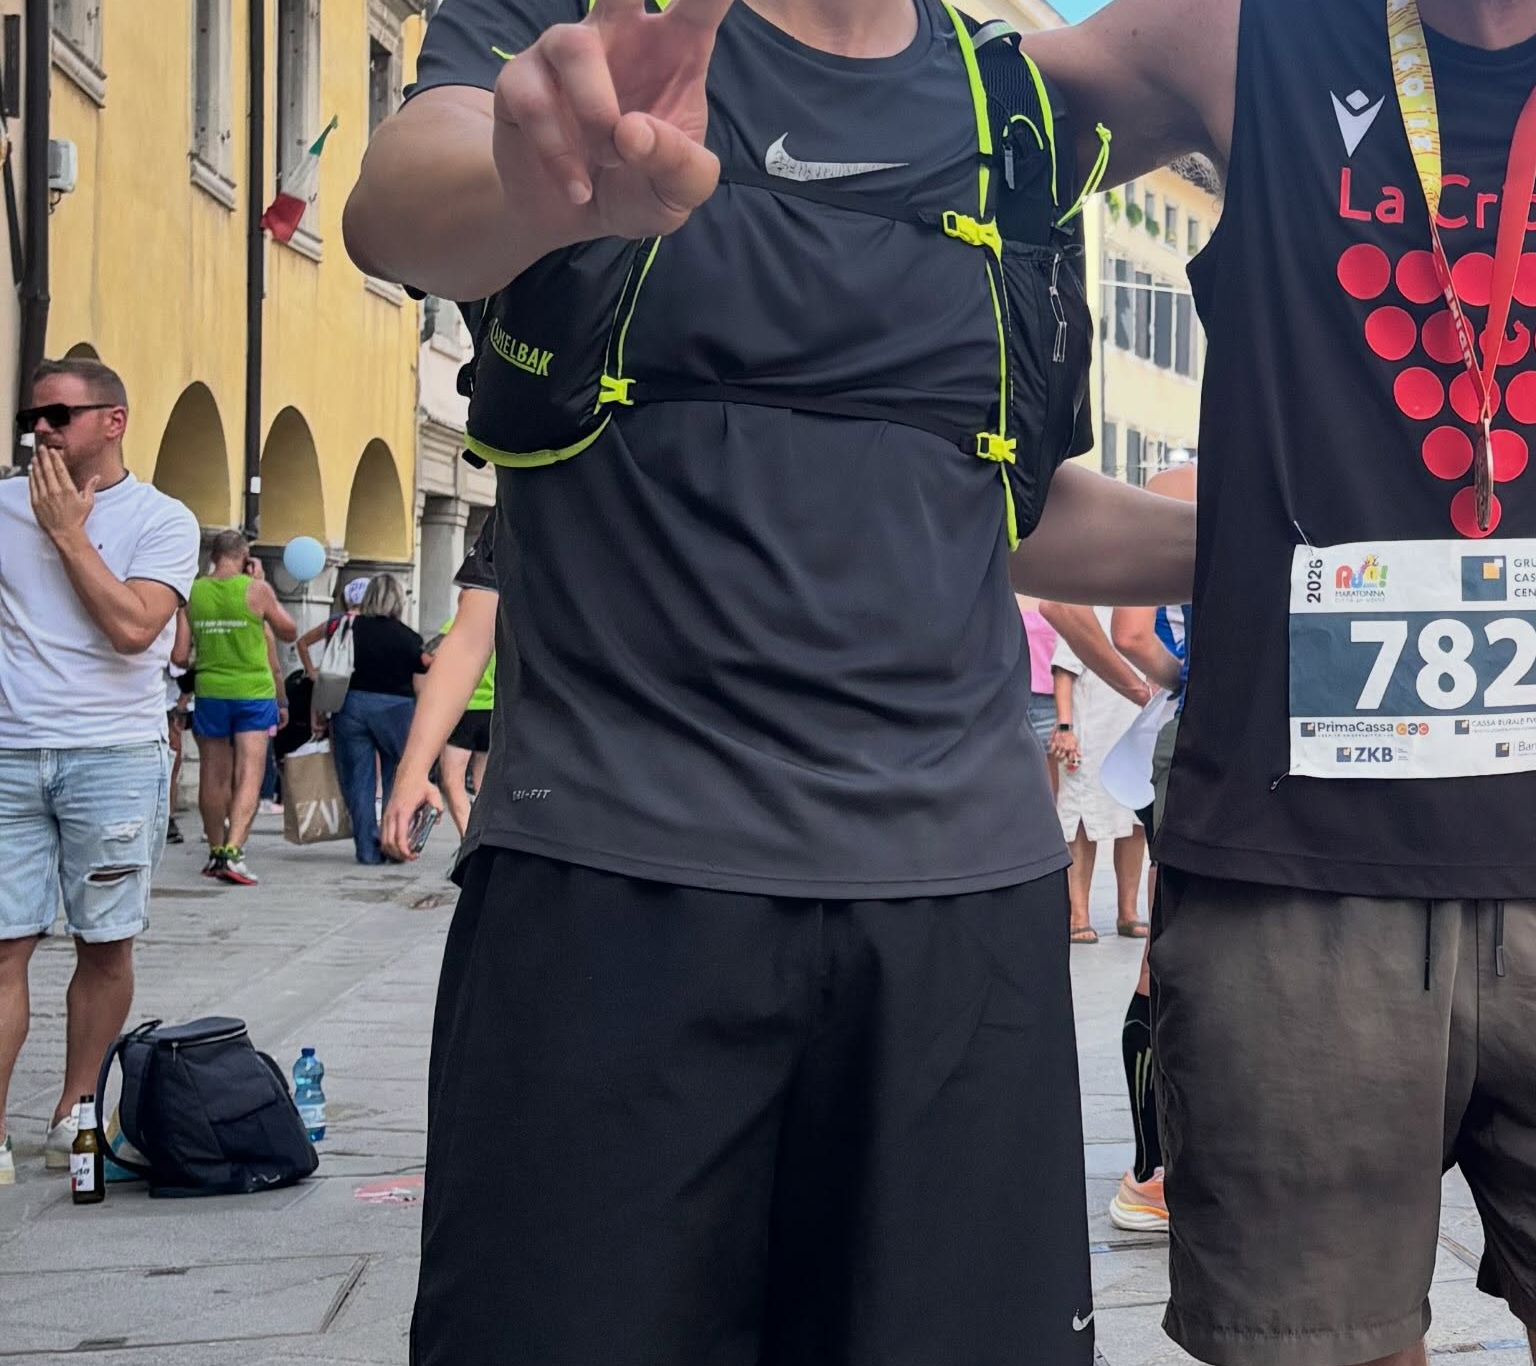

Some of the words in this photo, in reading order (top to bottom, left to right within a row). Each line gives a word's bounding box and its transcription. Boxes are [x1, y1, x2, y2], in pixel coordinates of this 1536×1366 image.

[1339, 166, 1405, 224] La
[1306, 558, 1324, 604] 2026
[1317, 721, 1394, 733] PrimaCassa
[1354, 747, 1394, 763] ZKB
